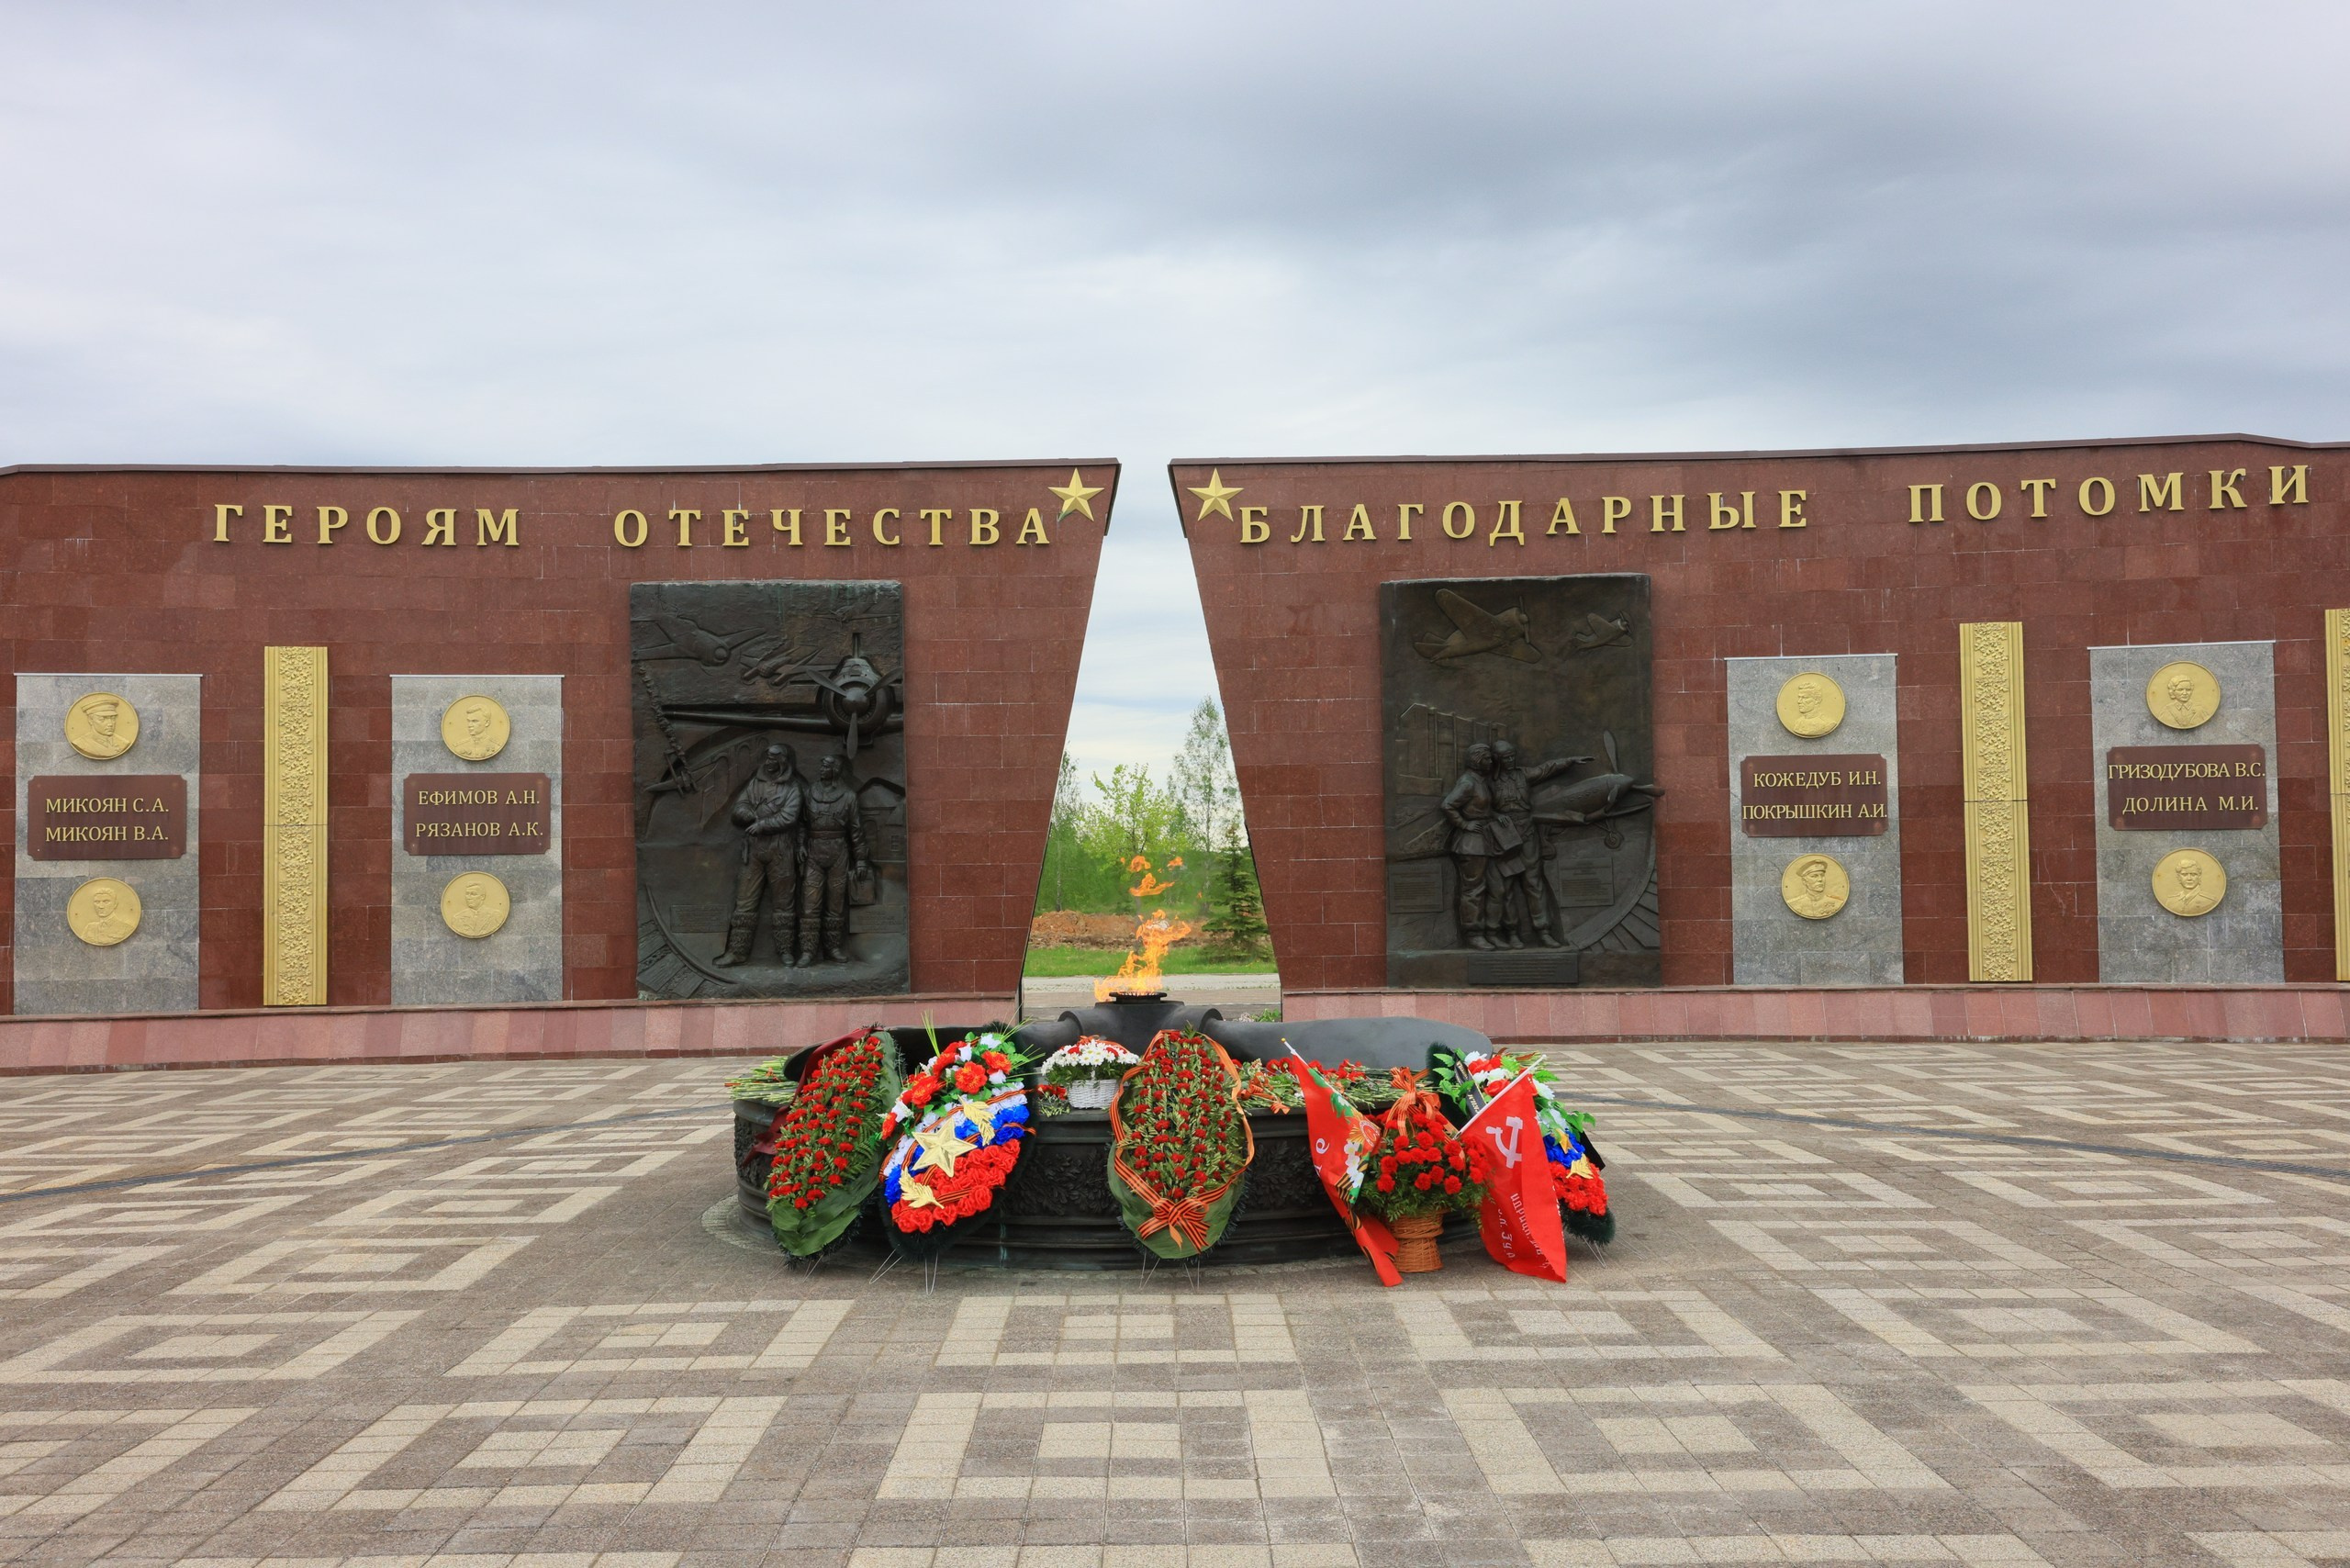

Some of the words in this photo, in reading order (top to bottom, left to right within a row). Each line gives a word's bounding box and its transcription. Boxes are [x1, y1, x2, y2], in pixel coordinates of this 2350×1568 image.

[1239, 488, 1807, 547] БЛАГОДАРНЫЕ
[1908, 464, 2310, 523] ПОТОМКИ
[213, 503, 520, 547] ГЕРОЯМ
[614, 507, 1051, 548] ОТЕЧЕСТВА
[1753, 771, 1841, 790] КОЖЕДУБ
[1848, 770, 1881, 786] И.Н.
[2108, 762, 2231, 781] ГРИЗОДУБОВА
[2234, 762, 2266, 778] В.С.
[45, 797, 127, 813] МИКОЯН
[132, 797, 170, 813] С.А.
[418, 790, 498, 806] ЕФИМОВ
[505, 790, 540, 805] А.Н.
[2121, 796, 2208, 815] ДОЛИНА
[2218, 795, 2259, 811] М.И.
[1741, 803, 1852, 820] ПОКРЫШКИН
[1857, 803, 1887, 818] А.И.
[45, 825, 127, 842] МИКОЯН
[133, 824, 169, 841] В.А.
[415, 822, 500, 837] РЯЗАНОВ
[508, 821, 543, 836] А.К.
